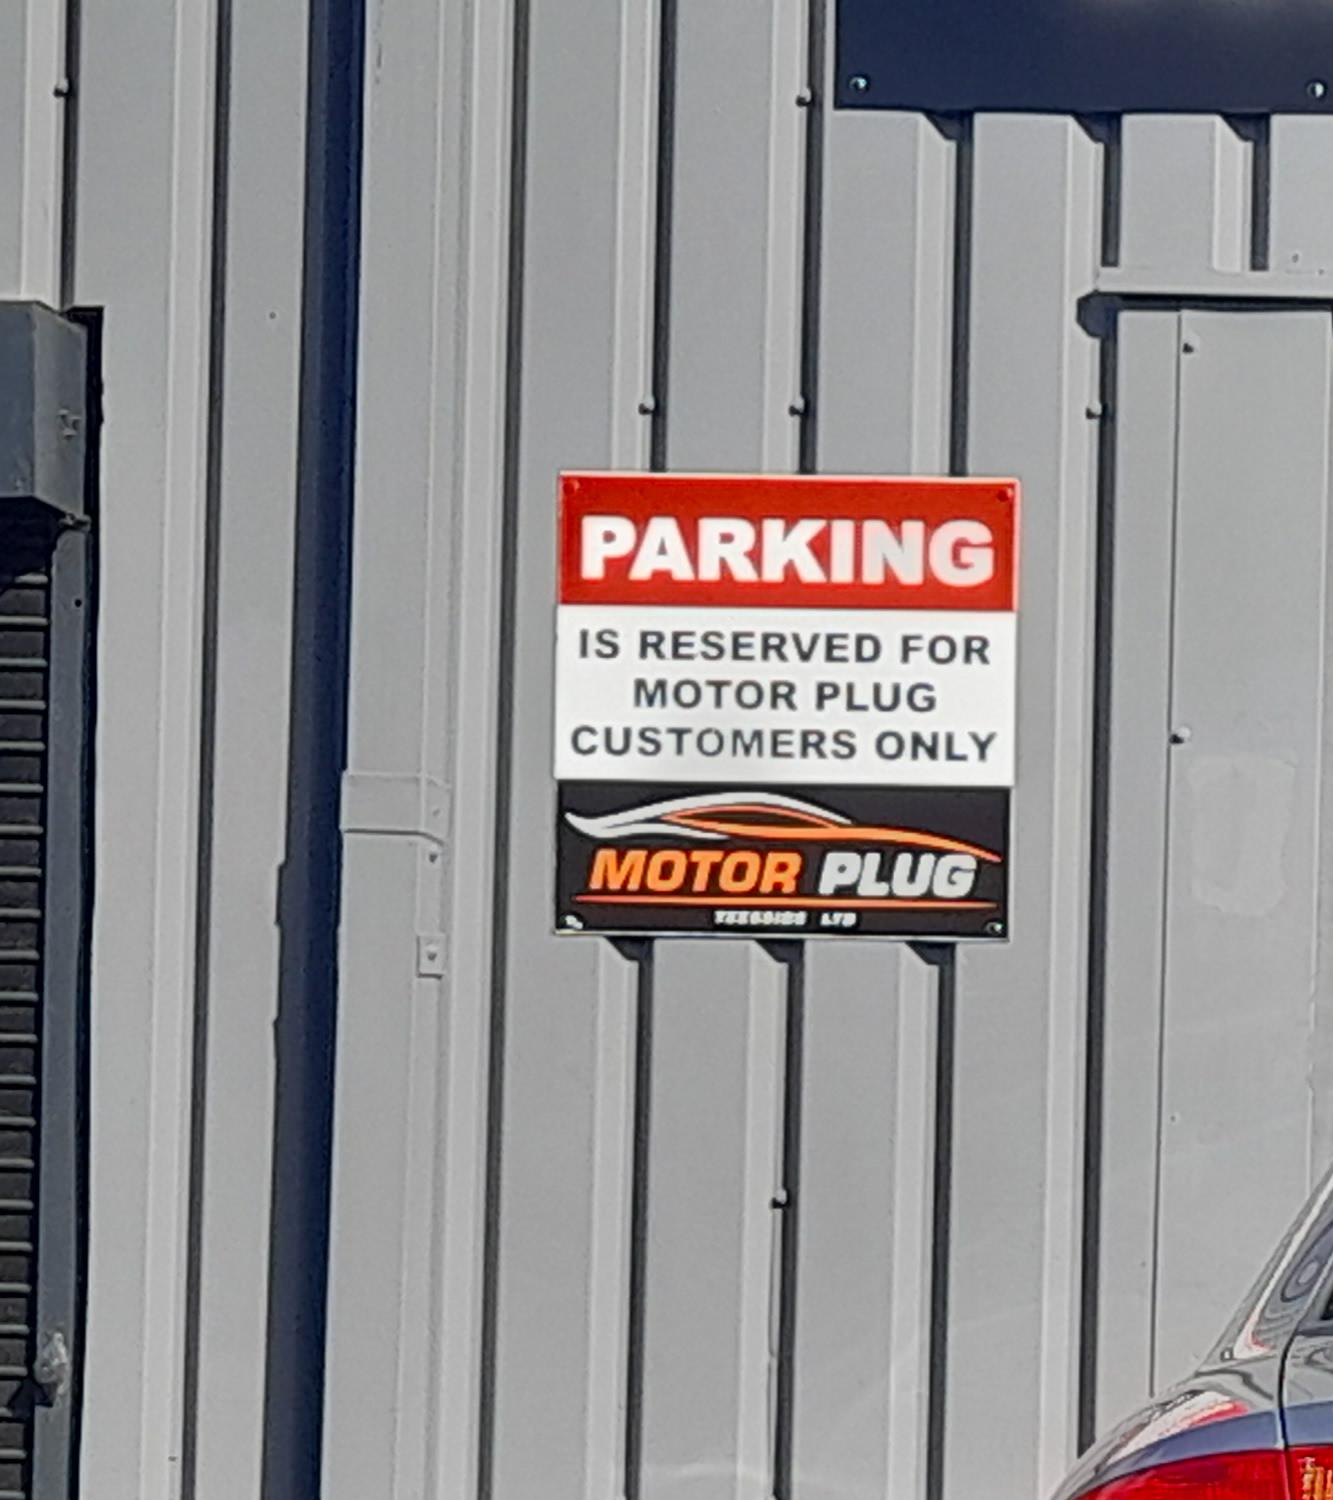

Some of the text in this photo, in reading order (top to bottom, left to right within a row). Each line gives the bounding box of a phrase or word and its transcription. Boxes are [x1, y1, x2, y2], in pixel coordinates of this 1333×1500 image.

[580, 515, 996, 587] PARKING
[579, 629, 990, 664] IS RESERVED FOR
[633, 679, 937, 713] MOTOR PLUG
[571, 726, 997, 762] CUSTOMERS ONLY
[589, 849, 978, 897] MOTOR PLUG
